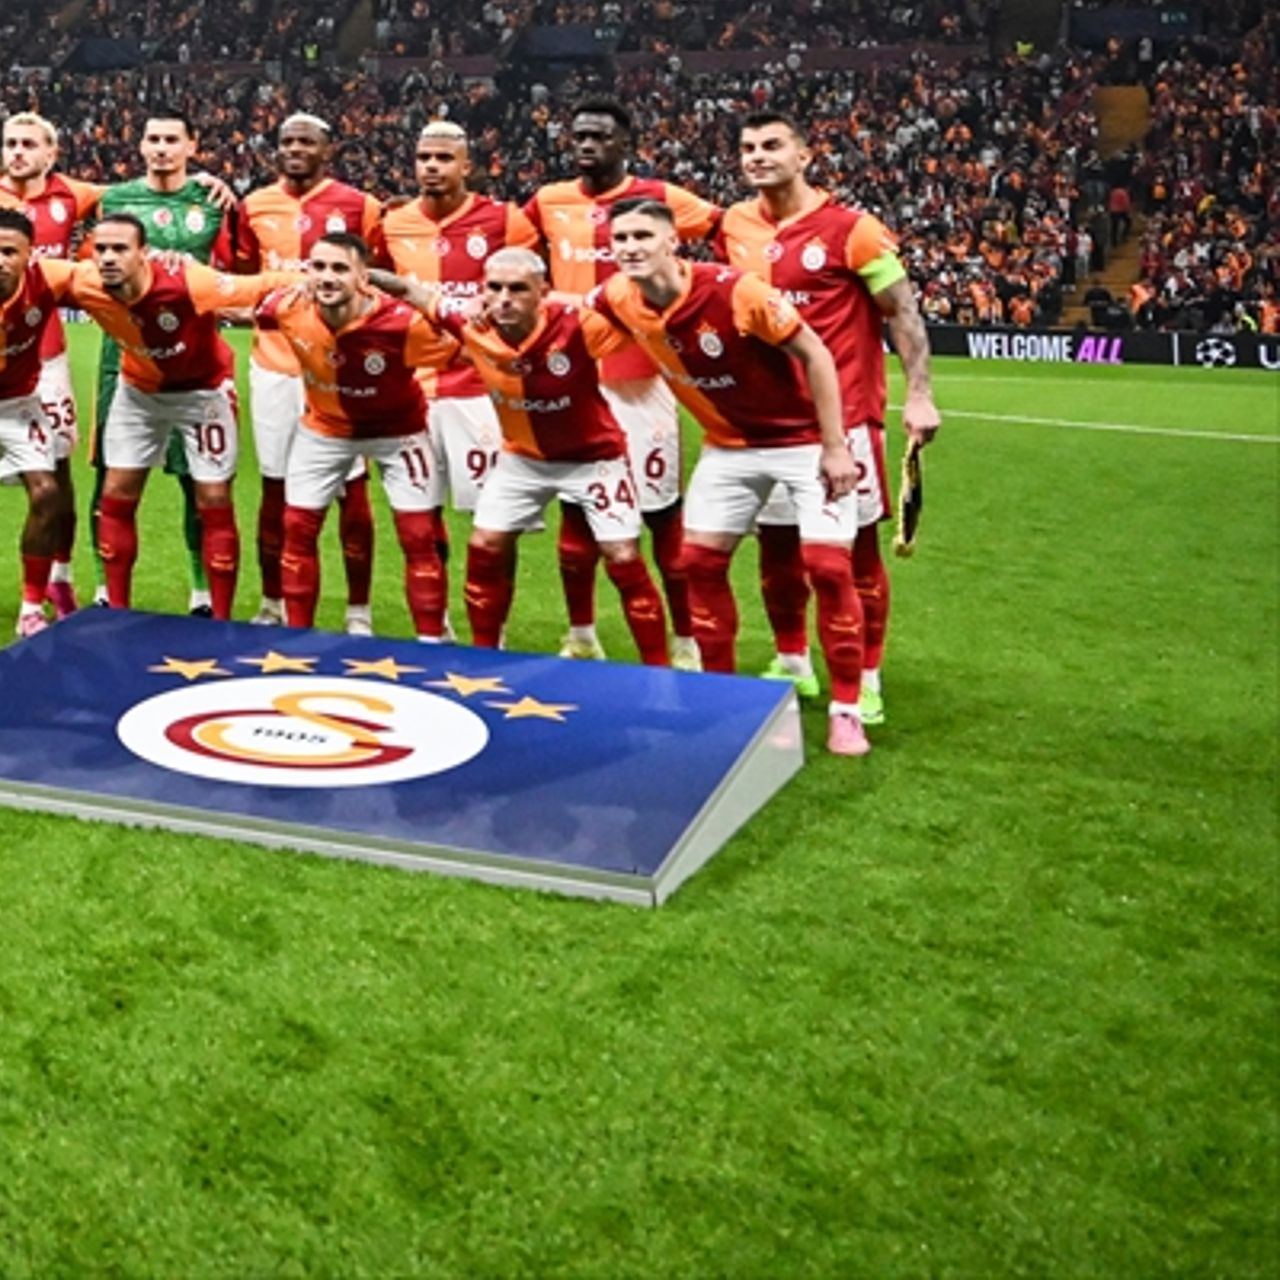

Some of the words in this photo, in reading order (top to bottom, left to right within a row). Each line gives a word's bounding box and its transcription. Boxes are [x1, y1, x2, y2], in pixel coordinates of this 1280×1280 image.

[967, 332, 1073, 362] WELCOME
[1075, 335, 1124, 364] ALL
[41, 397, 76, 429] 53
[193, 422, 226, 454] 10
[400, 447, 430, 479] 11
[645, 447, 666, 480] 6
[588, 479, 634, 512] 34
